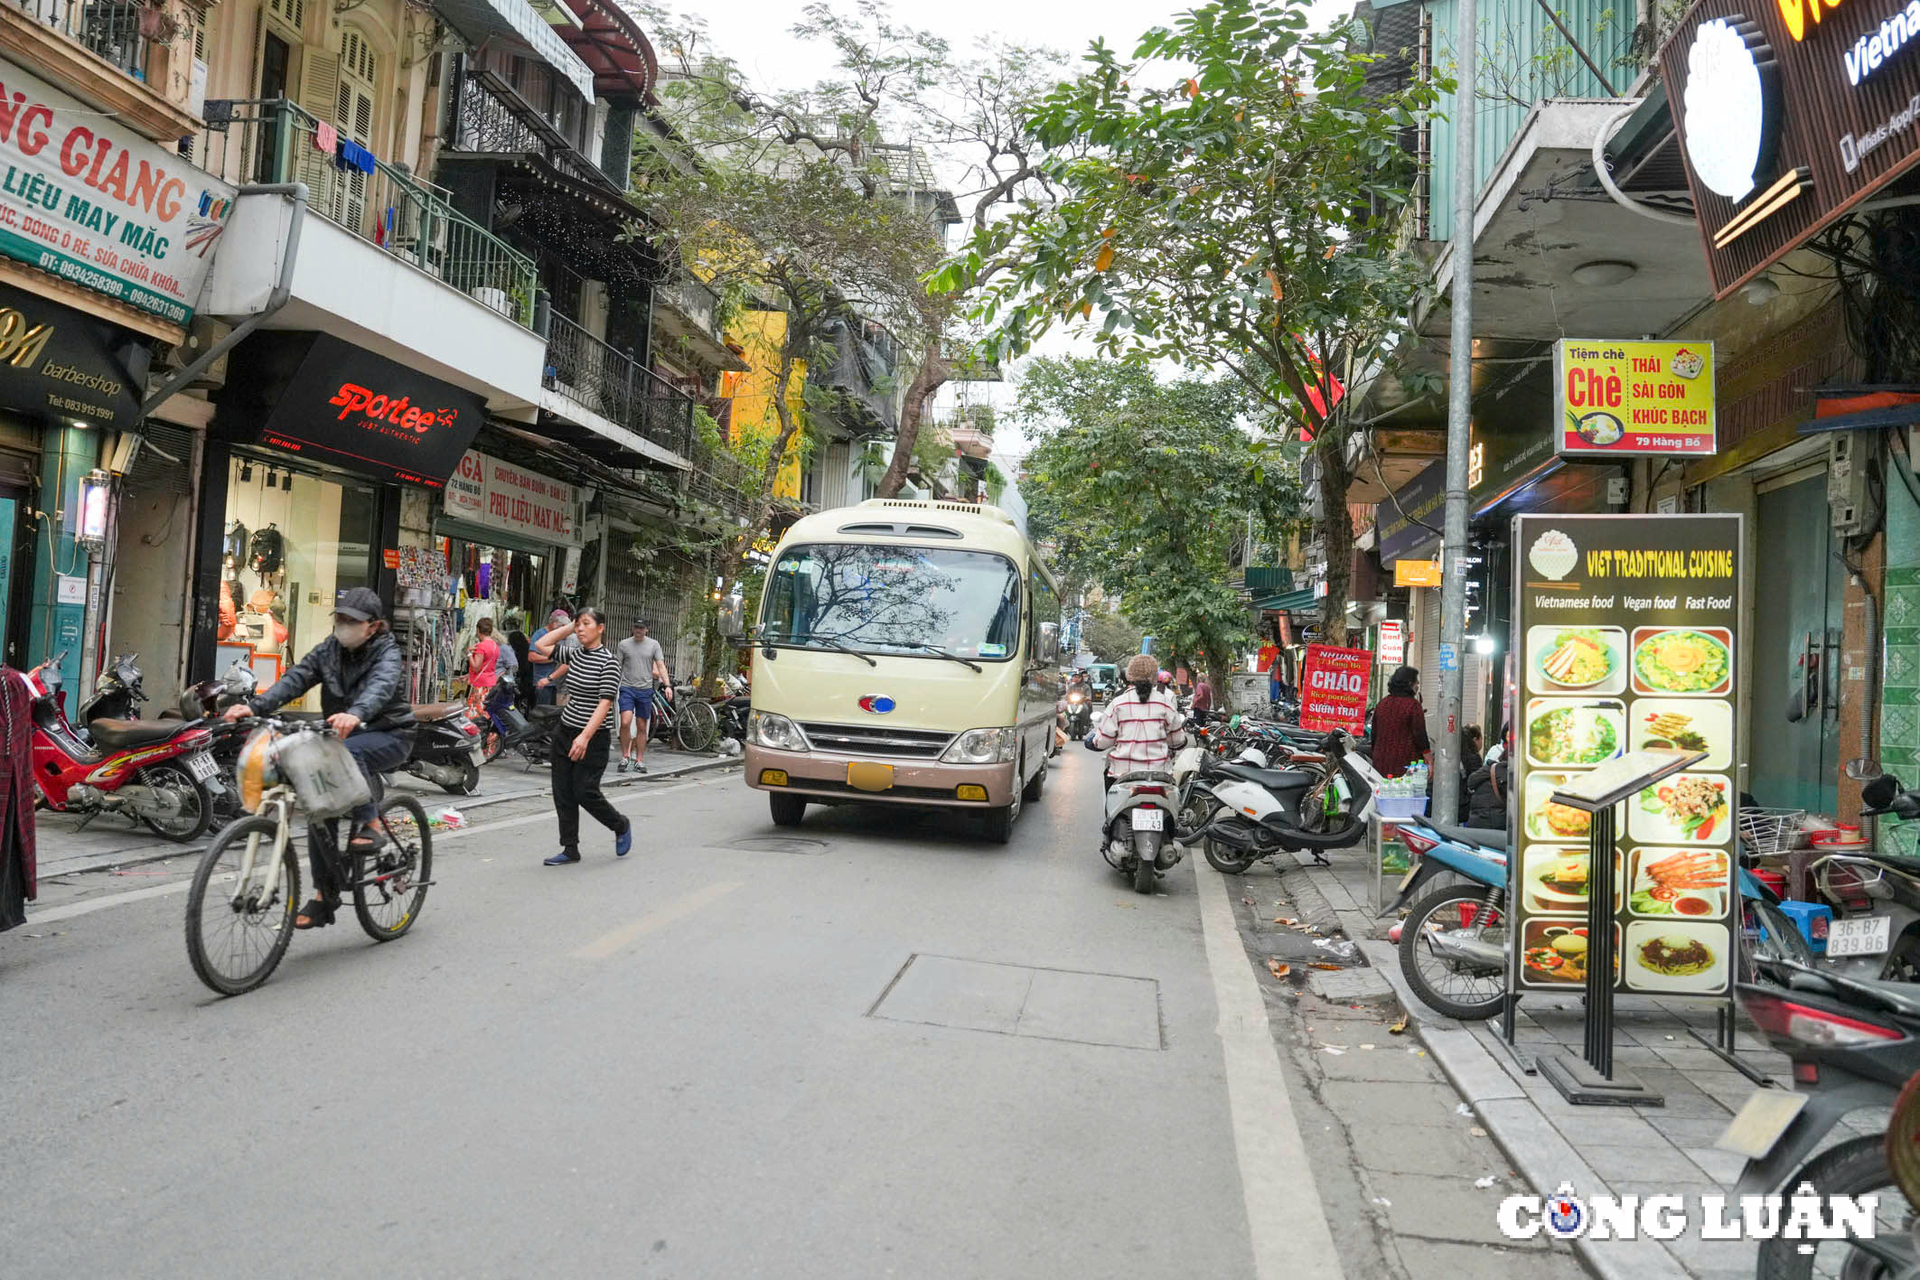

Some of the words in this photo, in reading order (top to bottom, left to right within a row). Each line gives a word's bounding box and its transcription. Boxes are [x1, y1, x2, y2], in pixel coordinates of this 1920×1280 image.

[59, 126, 186, 223] GIANG
[2, 165, 63, 210] LIỆU
[64, 194, 120, 237] MAY
[119, 220, 170, 260] MẶC
[39, 252, 59, 271] ĐT:
[1569, 347, 1599, 361] Tiệm
[1601, 348, 1625, 360] chè
[1631, 355, 1661, 373] THÁI
[41, 358, 122, 398] barbershop
[1568, 366, 1622, 408] Chè
[1632, 379, 1654, 398] SÀI
[1658, 379, 1685, 399] GÒN
[1633, 405, 1668, 425] KHÚC
[1672, 409, 1707, 428] BẠCH
[1636, 436, 1650, 446] 79
[1652, 436, 1682, 449] Hàng
[489, 491, 510, 524] PHỤ
[533, 504, 552, 529] MAY
[1586, 549, 1612, 578] VIET
[1613, 549, 1687, 579] TRADITIONAL
[1688, 549, 1733, 578] CUISINE
[1535, 595, 1590, 608] Vietnamese
[1591, 595, 1615, 608] food
[1623, 596, 1652, 611] Vegan
[1653, 596, 1677, 609] food
[1685, 597, 1705, 609] Fast
[1706, 596, 1732, 609] Food
[1311, 670, 1362, 693] CHÁO
